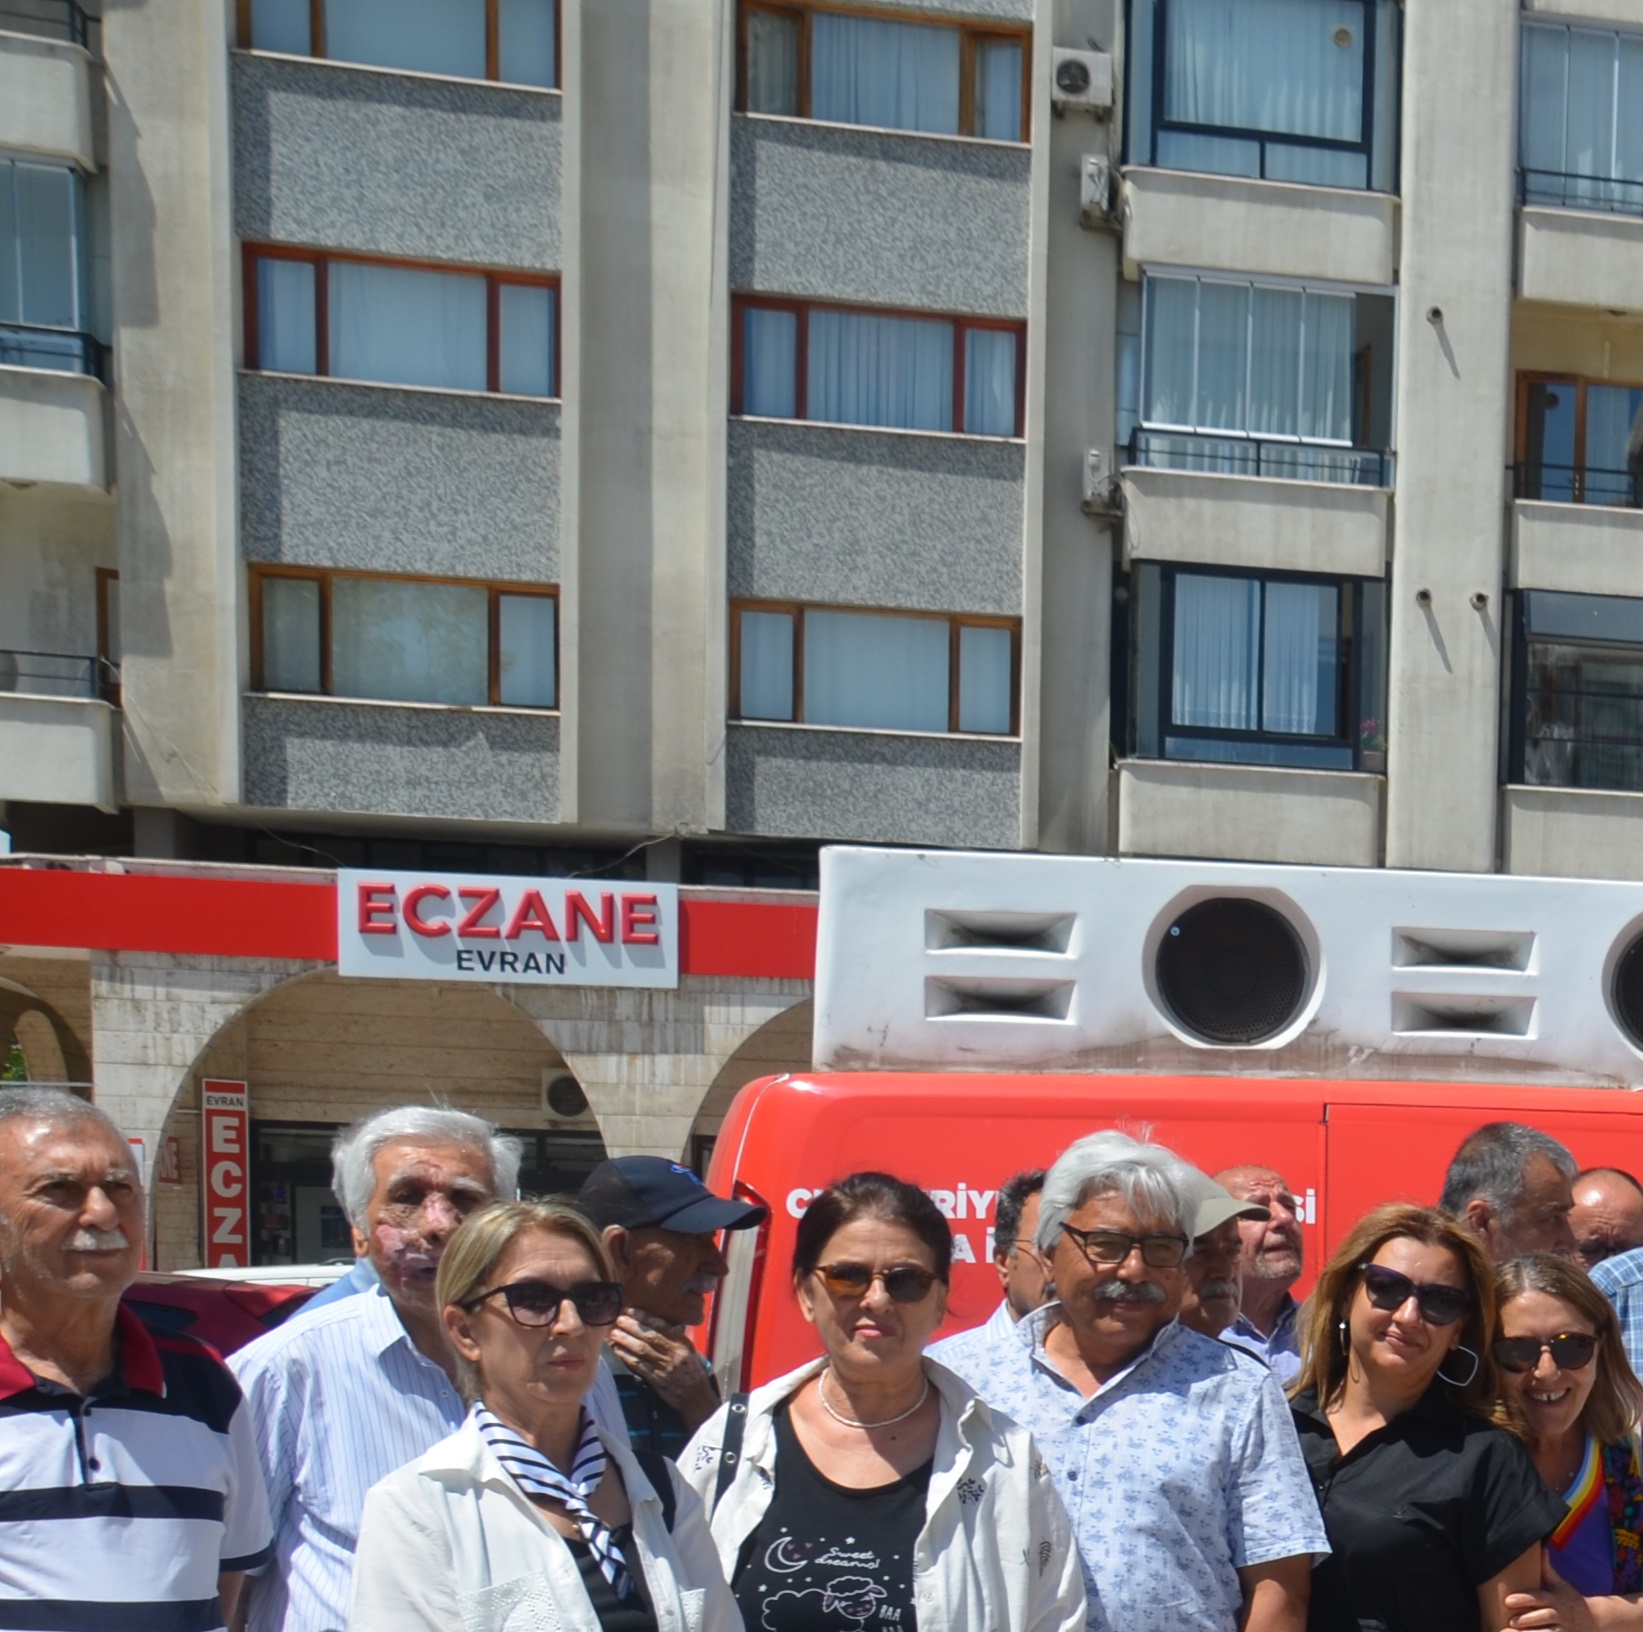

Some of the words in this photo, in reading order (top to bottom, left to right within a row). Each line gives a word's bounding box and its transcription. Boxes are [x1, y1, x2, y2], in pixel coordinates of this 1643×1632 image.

[357, 882, 660, 945] ECZANE
[456, 950, 566, 975] EVRAN
[206, 1095, 244, 1107] EVRAN
[879, 1604, 902, 1622] BAA
